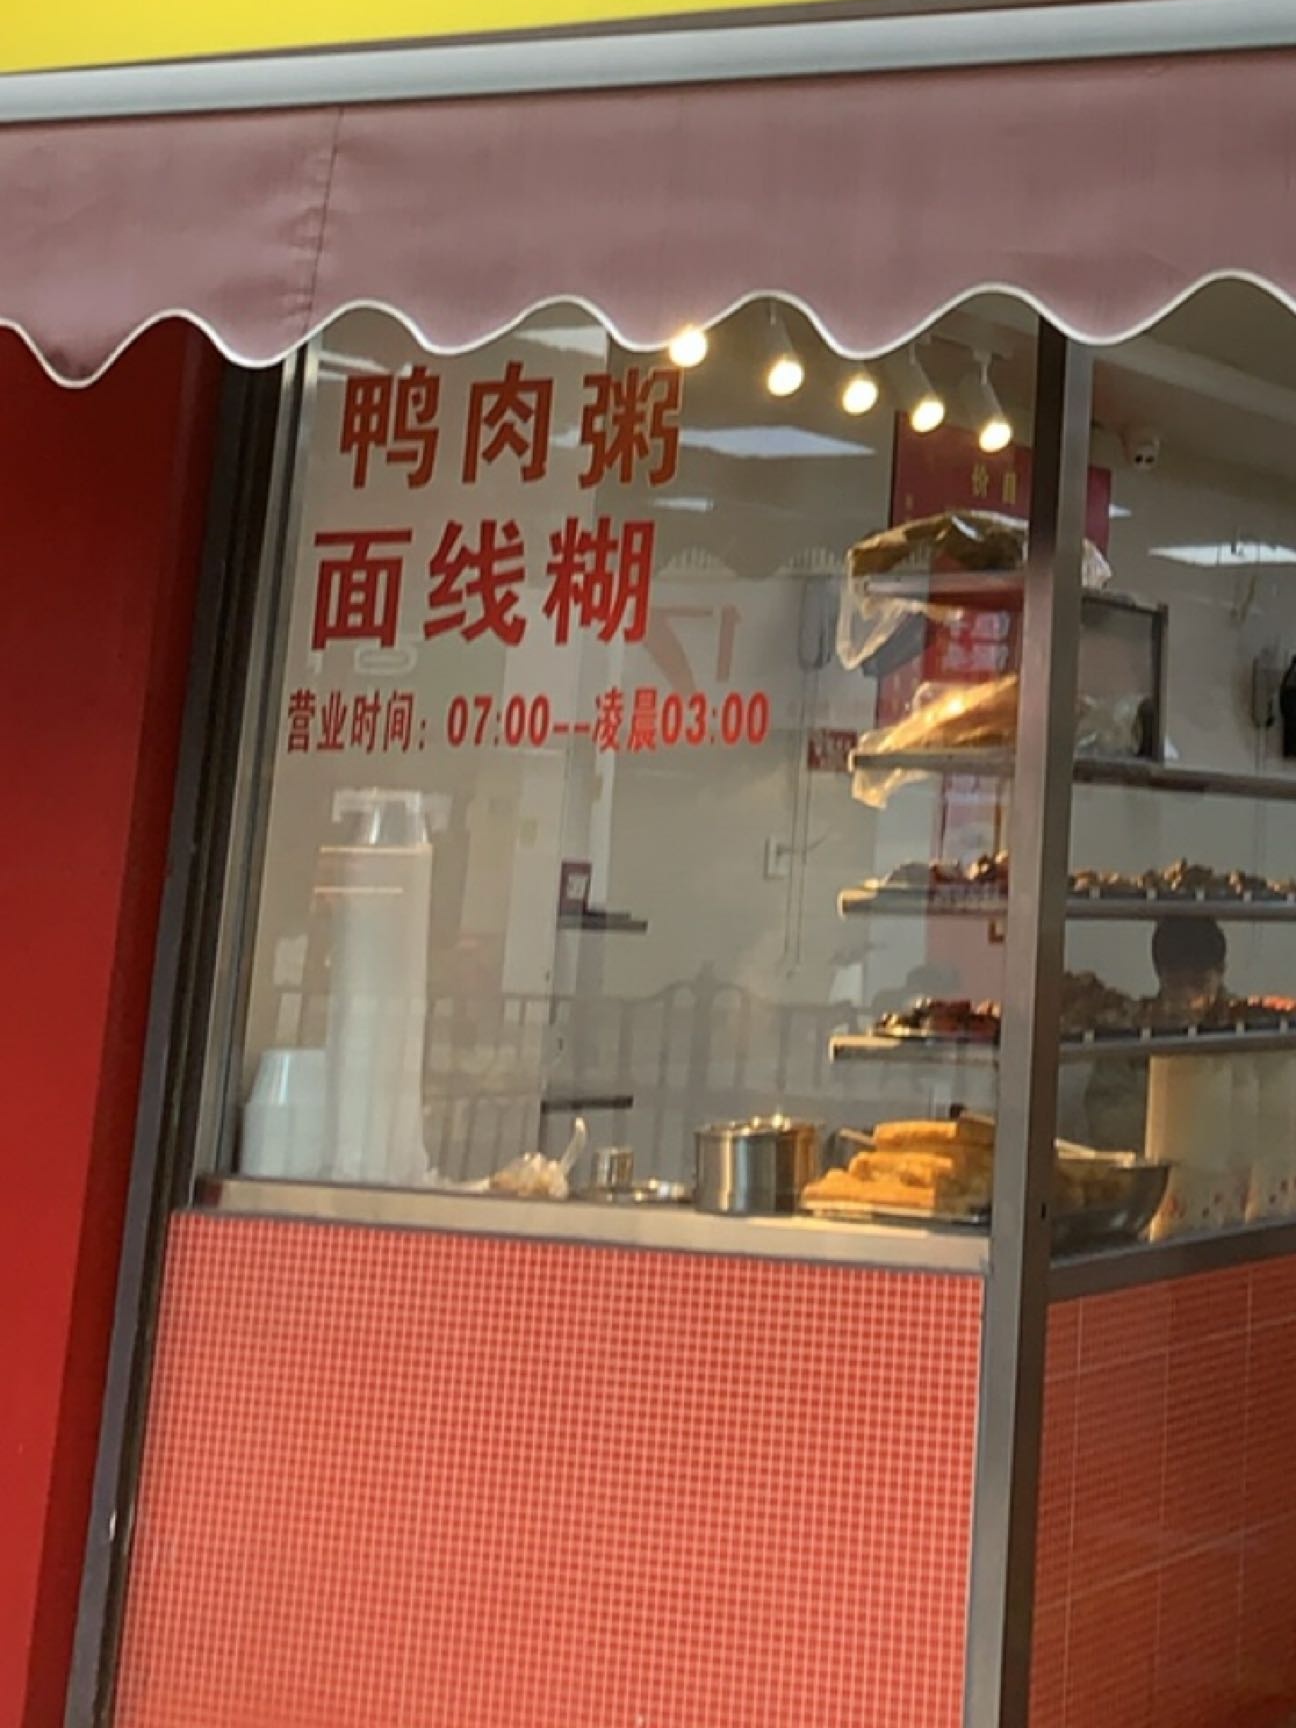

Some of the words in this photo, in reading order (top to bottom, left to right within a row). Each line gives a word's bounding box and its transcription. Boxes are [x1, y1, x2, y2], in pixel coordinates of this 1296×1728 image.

[339, 359, 684, 490] 鸭肉粥
[311, 516, 656, 651] 面线糊
